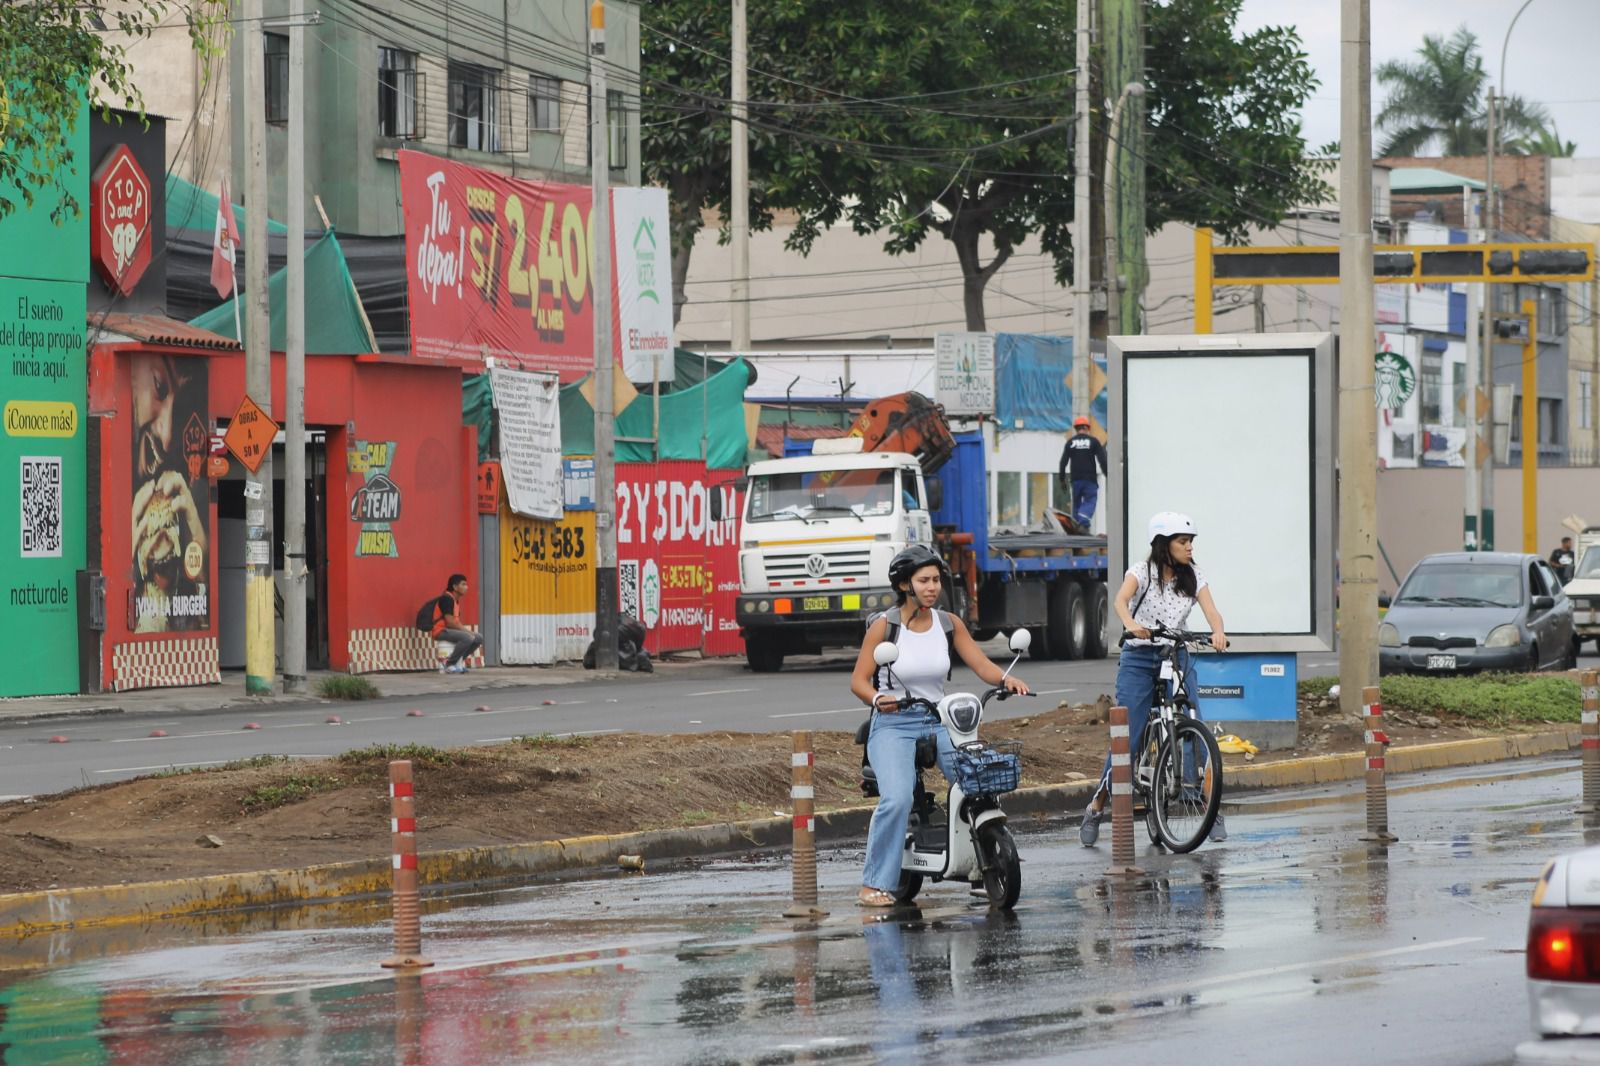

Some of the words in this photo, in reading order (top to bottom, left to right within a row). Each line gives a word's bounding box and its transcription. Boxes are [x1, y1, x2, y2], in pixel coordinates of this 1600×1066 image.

[108, 179, 142, 219] STOP
[426, 171, 451, 240] Tu
[117, 204, 134, 219] and
[112, 223, 137, 272] go
[417, 224, 465, 304] depa!
[18, 296, 28, 320] El
[31, 299, 63, 322] sueño
[537, 308, 547, 328] AL
[548, 308, 565, 331] MES
[0, 322, 15, 346] del
[18, 323, 45, 353] depa
[47, 326, 82, 355] propio
[13, 353, 40, 377] inicia
[43, 356, 68, 383] aquí.
[8, 408, 49, 430] ¡Conoce
[50, 409, 73, 431] más!
[239, 410, 258, 425] OBRAS
[248, 429, 252, 440] A
[253, 444, 260, 456] M
[367, 443, 386, 467] CAR
[361, 530, 391, 555] WASH
[10, 579, 69, 606] natturale
[160, 596, 171, 616] LA
[172, 595, 207, 617] BURGER!
[1213, 687, 1240, 695] Channel
